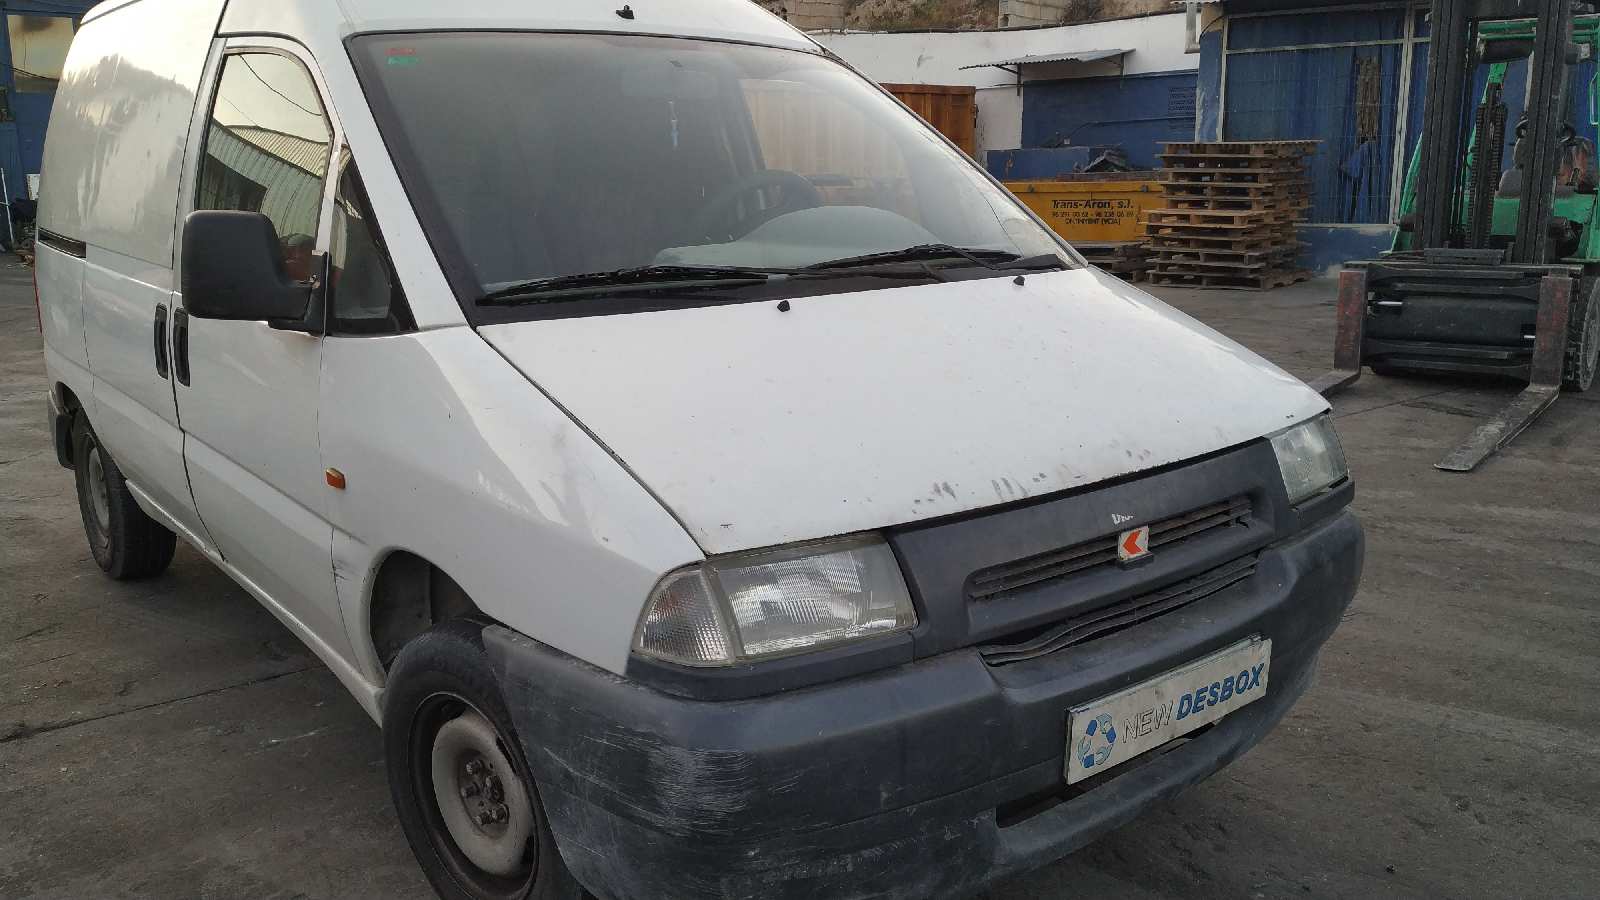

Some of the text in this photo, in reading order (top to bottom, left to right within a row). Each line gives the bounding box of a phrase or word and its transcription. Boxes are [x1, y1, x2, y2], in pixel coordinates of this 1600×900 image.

[1052, 200, 1114, 210] Trans-Aron,
[1122, 663, 1265, 743] NEW DESBOX
